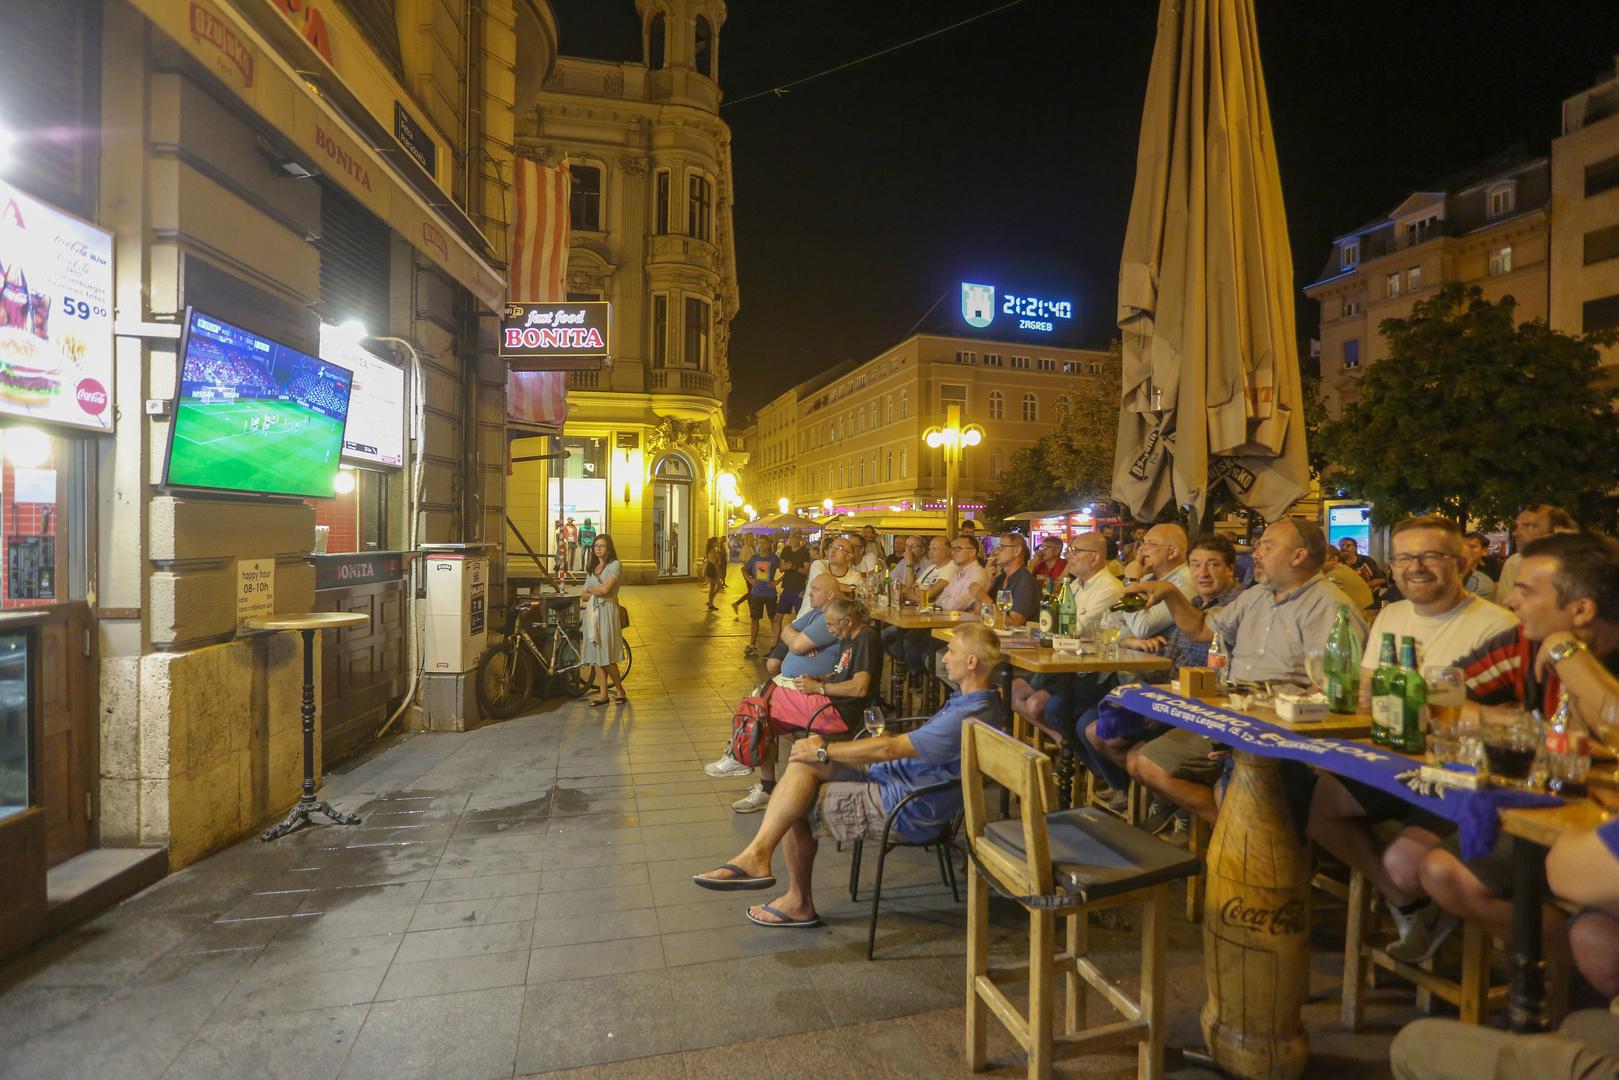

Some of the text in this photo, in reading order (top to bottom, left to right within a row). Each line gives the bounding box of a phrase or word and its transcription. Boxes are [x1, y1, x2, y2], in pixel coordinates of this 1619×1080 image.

[314, 125, 372, 193] BONITA
[63, 296, 107, 320] 59 00
[1003, 294, 1071, 319] 21:21:40
[525, 309, 586, 327] fast food
[1019, 319, 1053, 332] ZAGREB
[505, 328, 604, 348] BONITA
[241, 570, 272, 581] happy hour
[243, 582, 269, 594] 08-10h
[1152, 701, 1169, 714] UEFA
[1170, 707, 1196, 722] Europa
[1196, 715, 1226, 733] League,
[1166, 699, 1252, 727] DINAMO
